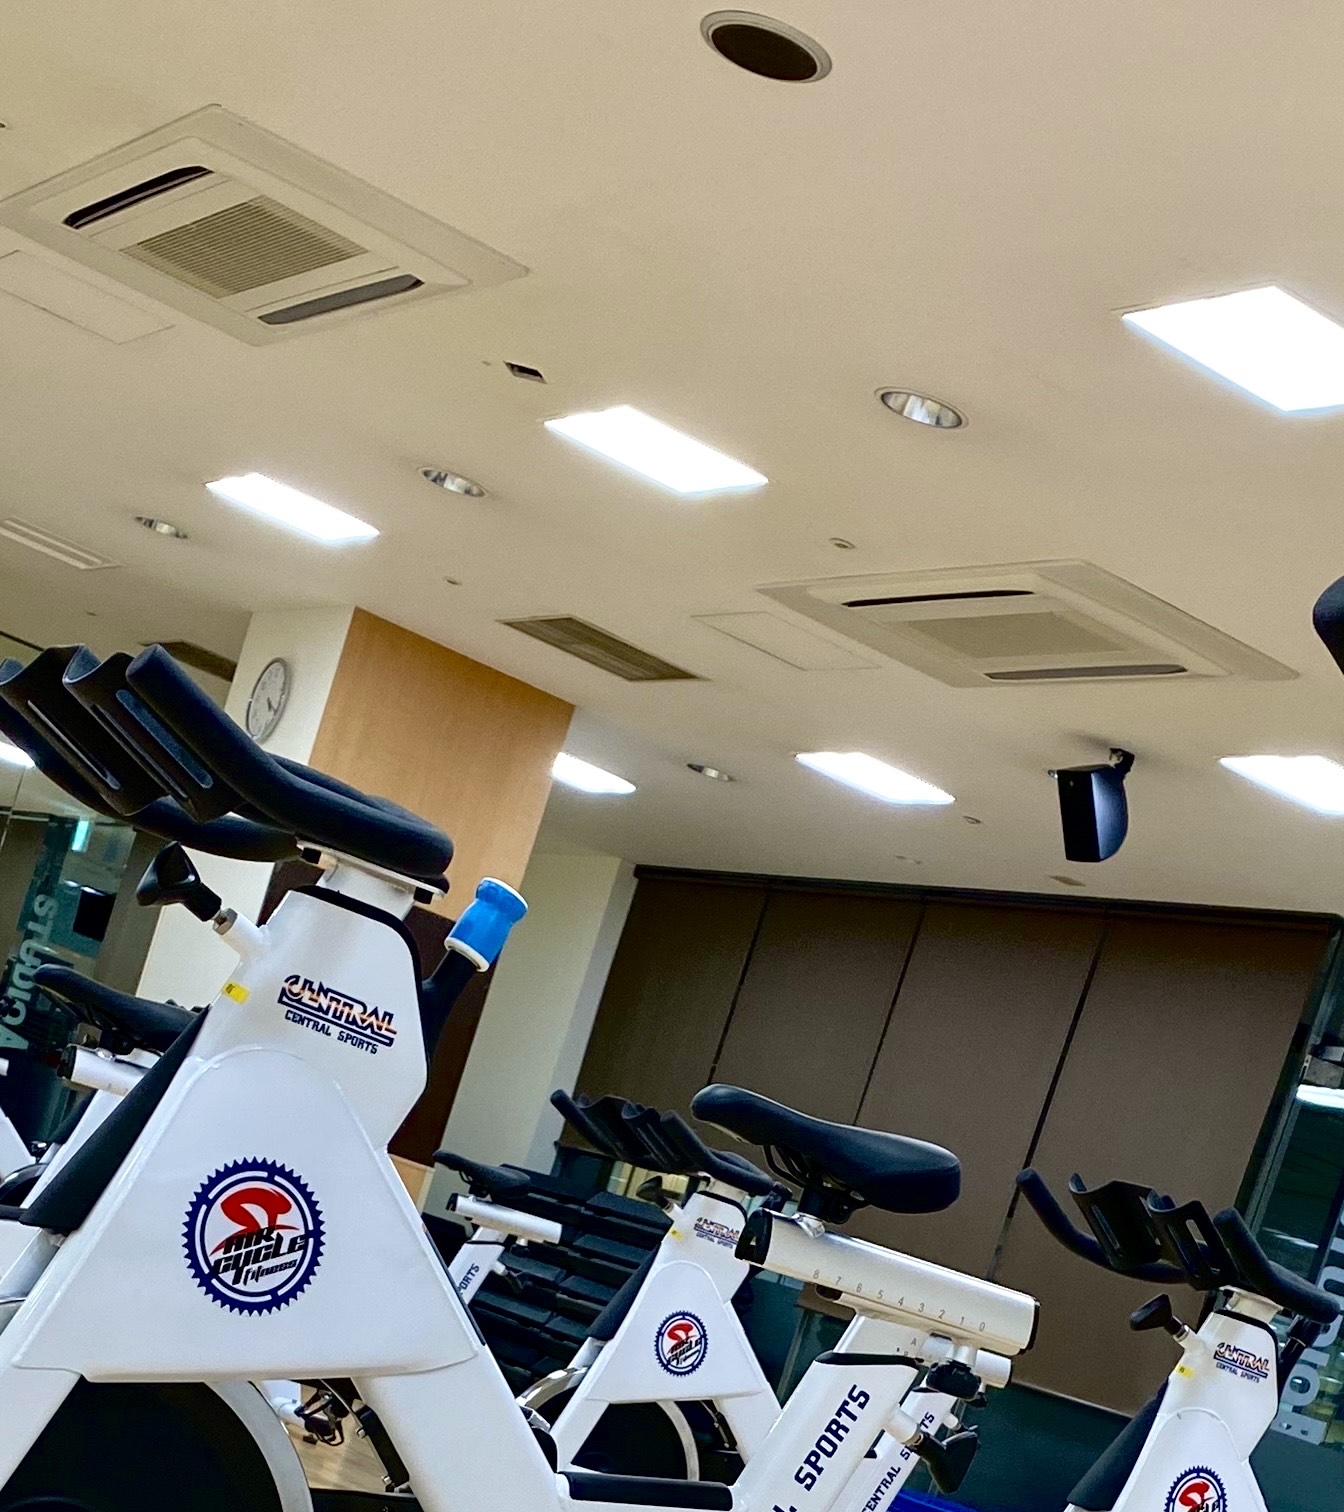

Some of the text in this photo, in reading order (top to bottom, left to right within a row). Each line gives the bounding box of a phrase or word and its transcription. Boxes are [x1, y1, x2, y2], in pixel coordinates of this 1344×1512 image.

[277, 974, 397, 1047] CENTRAL
[285, 1009, 379, 1054] CENTRAL SPORTS
[812, 1269, 820, 1280] 8
[835, 1276, 843, 1285] 7
[855, 1283, 863, 1293] 6
[877, 1289, 884, 1299] 5
[897, 1296, 905, 1306] 4
[918, 1302, 925, 1313] 3
[938, 1309, 946, 1320] 2
[1213, 1342, 1270, 1379] CENTRAL
[794, 1384, 871, 1491] SPORTS
